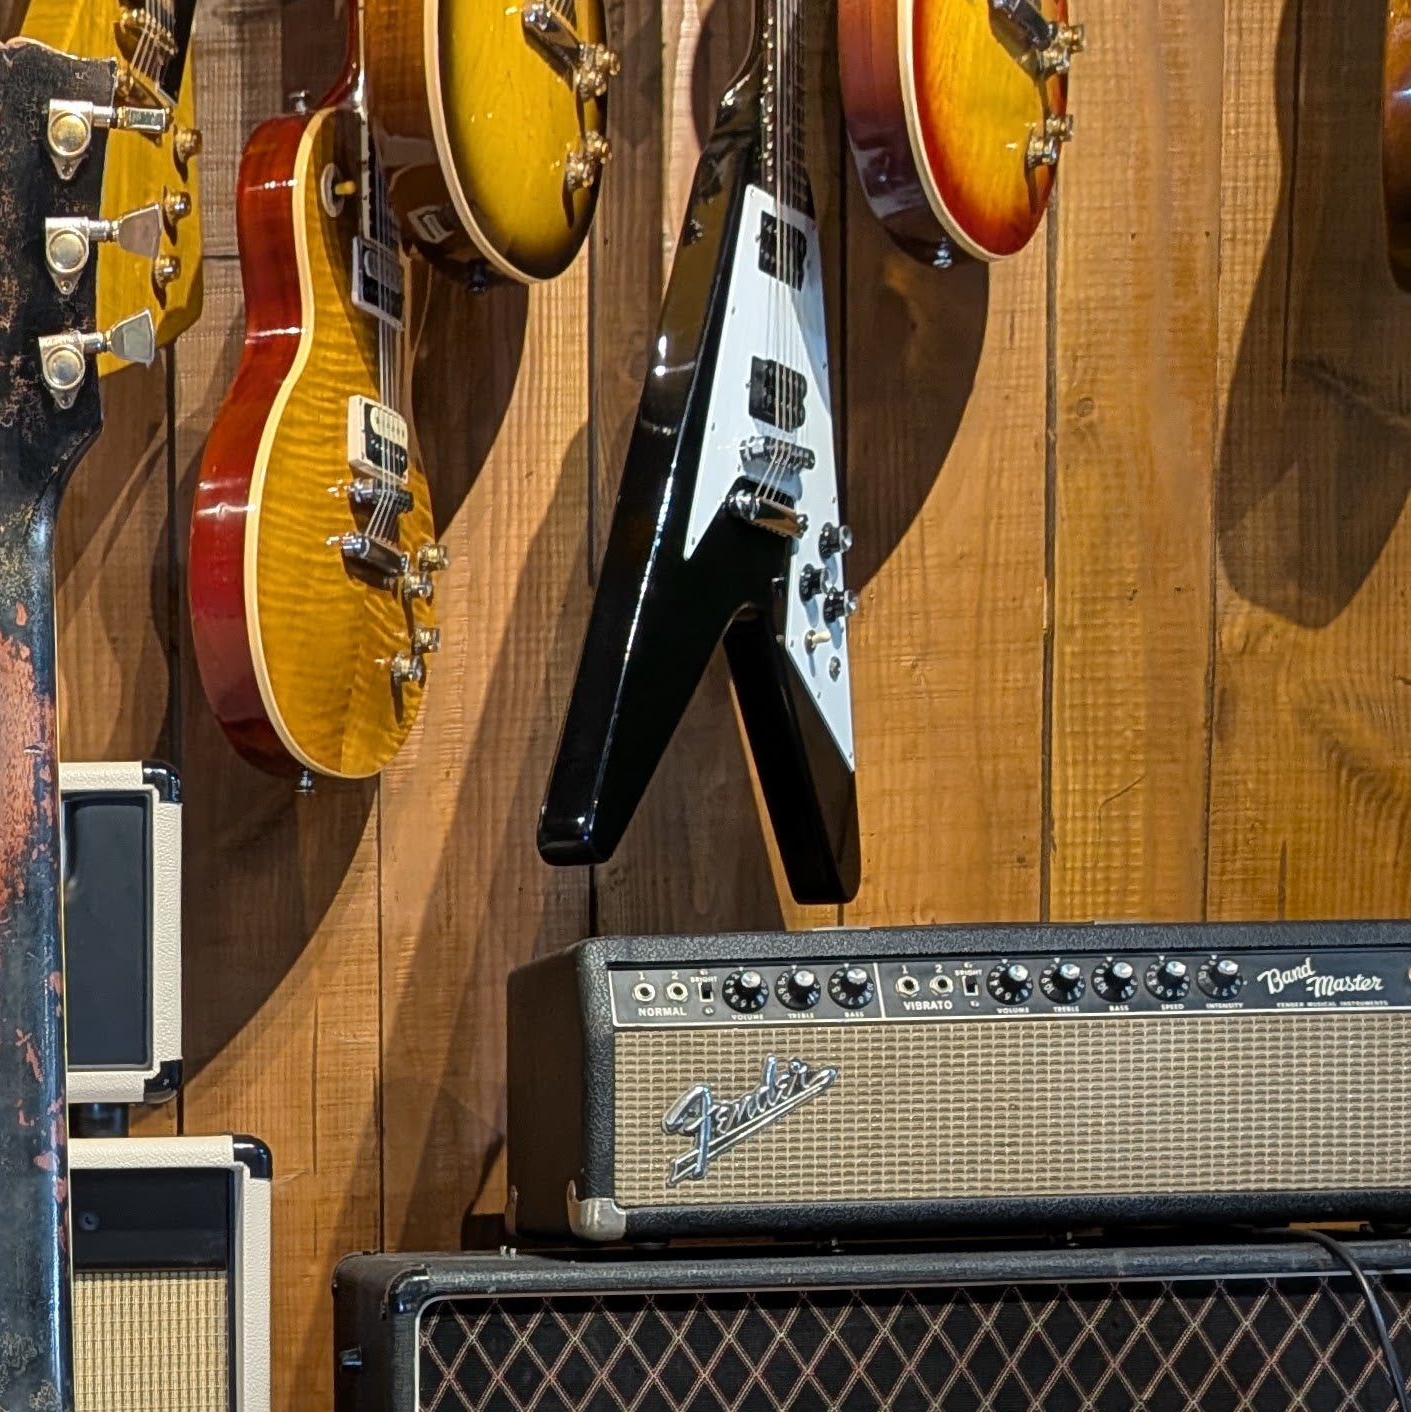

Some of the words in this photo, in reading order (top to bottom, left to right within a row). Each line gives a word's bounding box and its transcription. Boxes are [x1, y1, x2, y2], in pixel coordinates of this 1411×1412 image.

[954, 968, 983, 976] BRIGHT
[1256, 957, 1316, 995] Band
[689, 975, 718, 983] BRIGHT
[903, 1000, 953, 1011] VIBRATO
[1053, 1005, 1080, 1013] TREBLE
[1109, 1004, 1130, 1012] BASS
[1160, 1003, 1185, 1011] SPEED
[638, 1006, 687, 1017] NORMAL
[996, 1006, 1030, 1014] VOLUME
[662, 1053, 837, 1181] Fender
